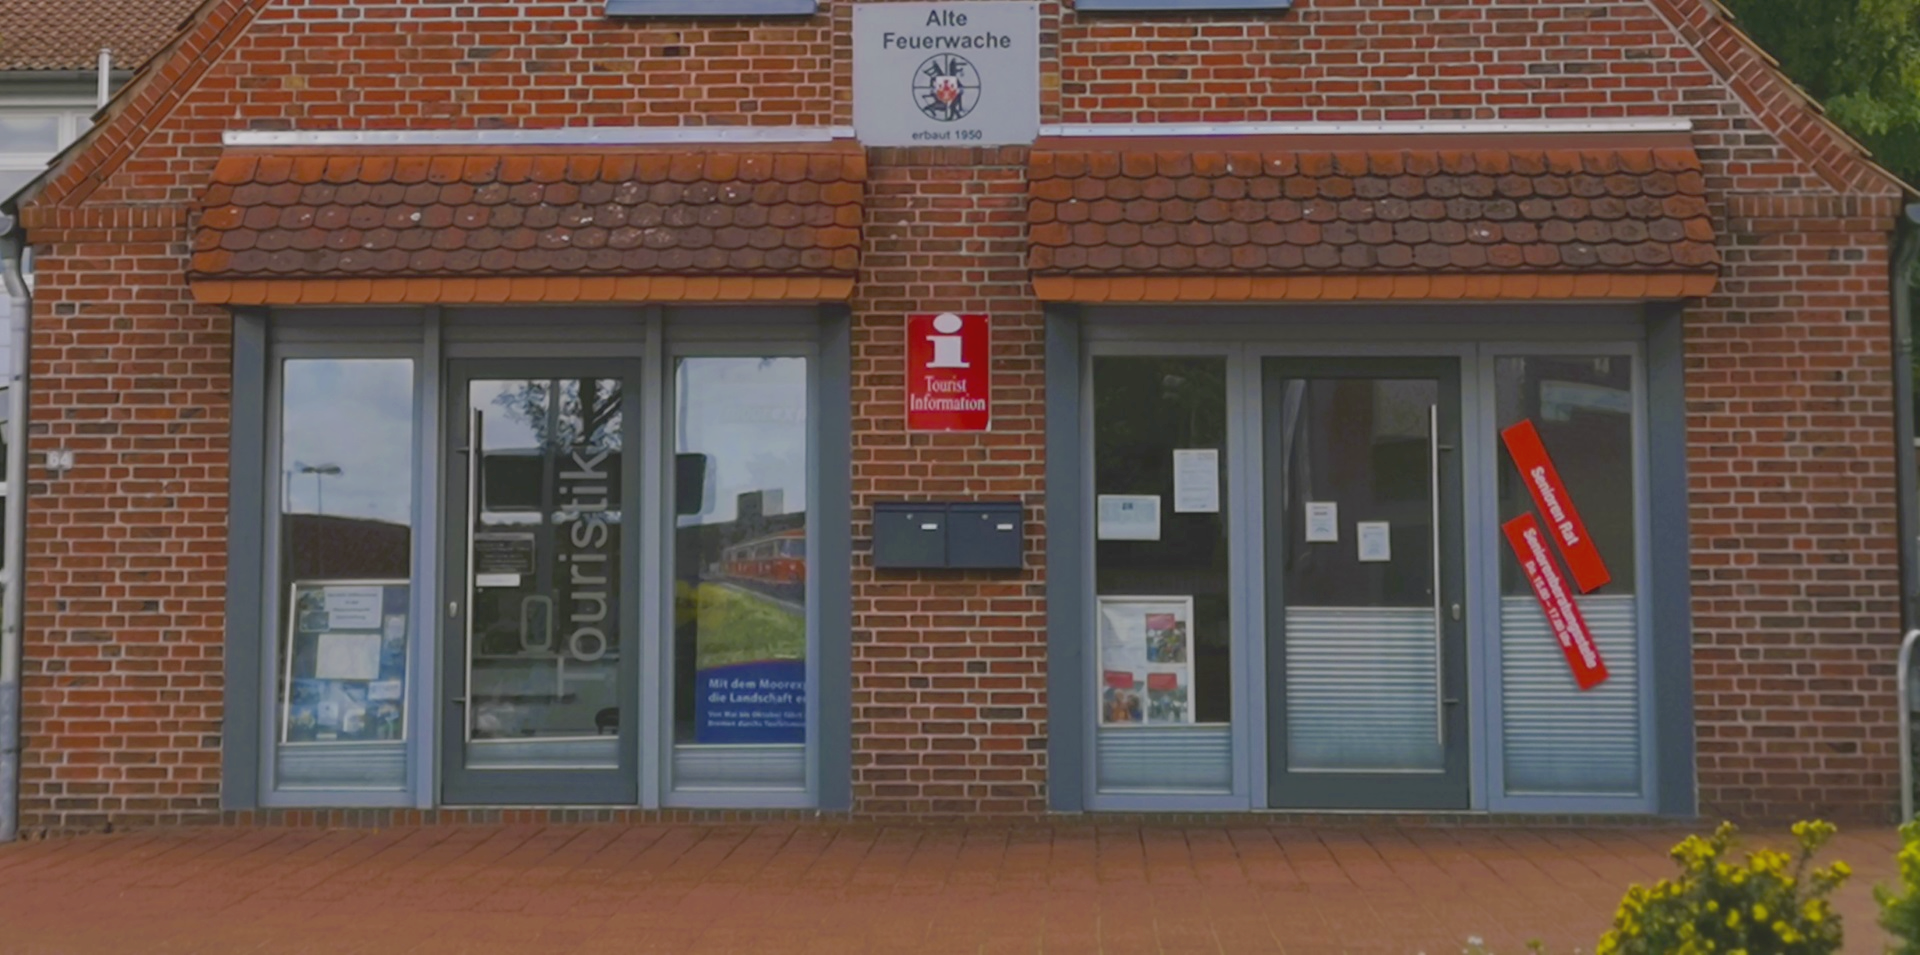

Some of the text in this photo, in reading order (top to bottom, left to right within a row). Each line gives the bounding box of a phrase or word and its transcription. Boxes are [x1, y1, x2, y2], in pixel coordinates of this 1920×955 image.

[925, 9, 968, 27] Alte
[883, 31, 1012, 49] Feuerwache
[911, 130, 983, 140] erbaut 1950
[925, 375, 967, 392] Tourist
[910, 393, 987, 411] Information
[1530, 466, 1579, 546] Senioren Rat
[558, 450, 608, 699] Touristik
[708, 679, 729, 690] Mit
[730, 679, 757, 690] dem
[708, 692, 727, 703] die
[729, 692, 793, 704] Landschaft
